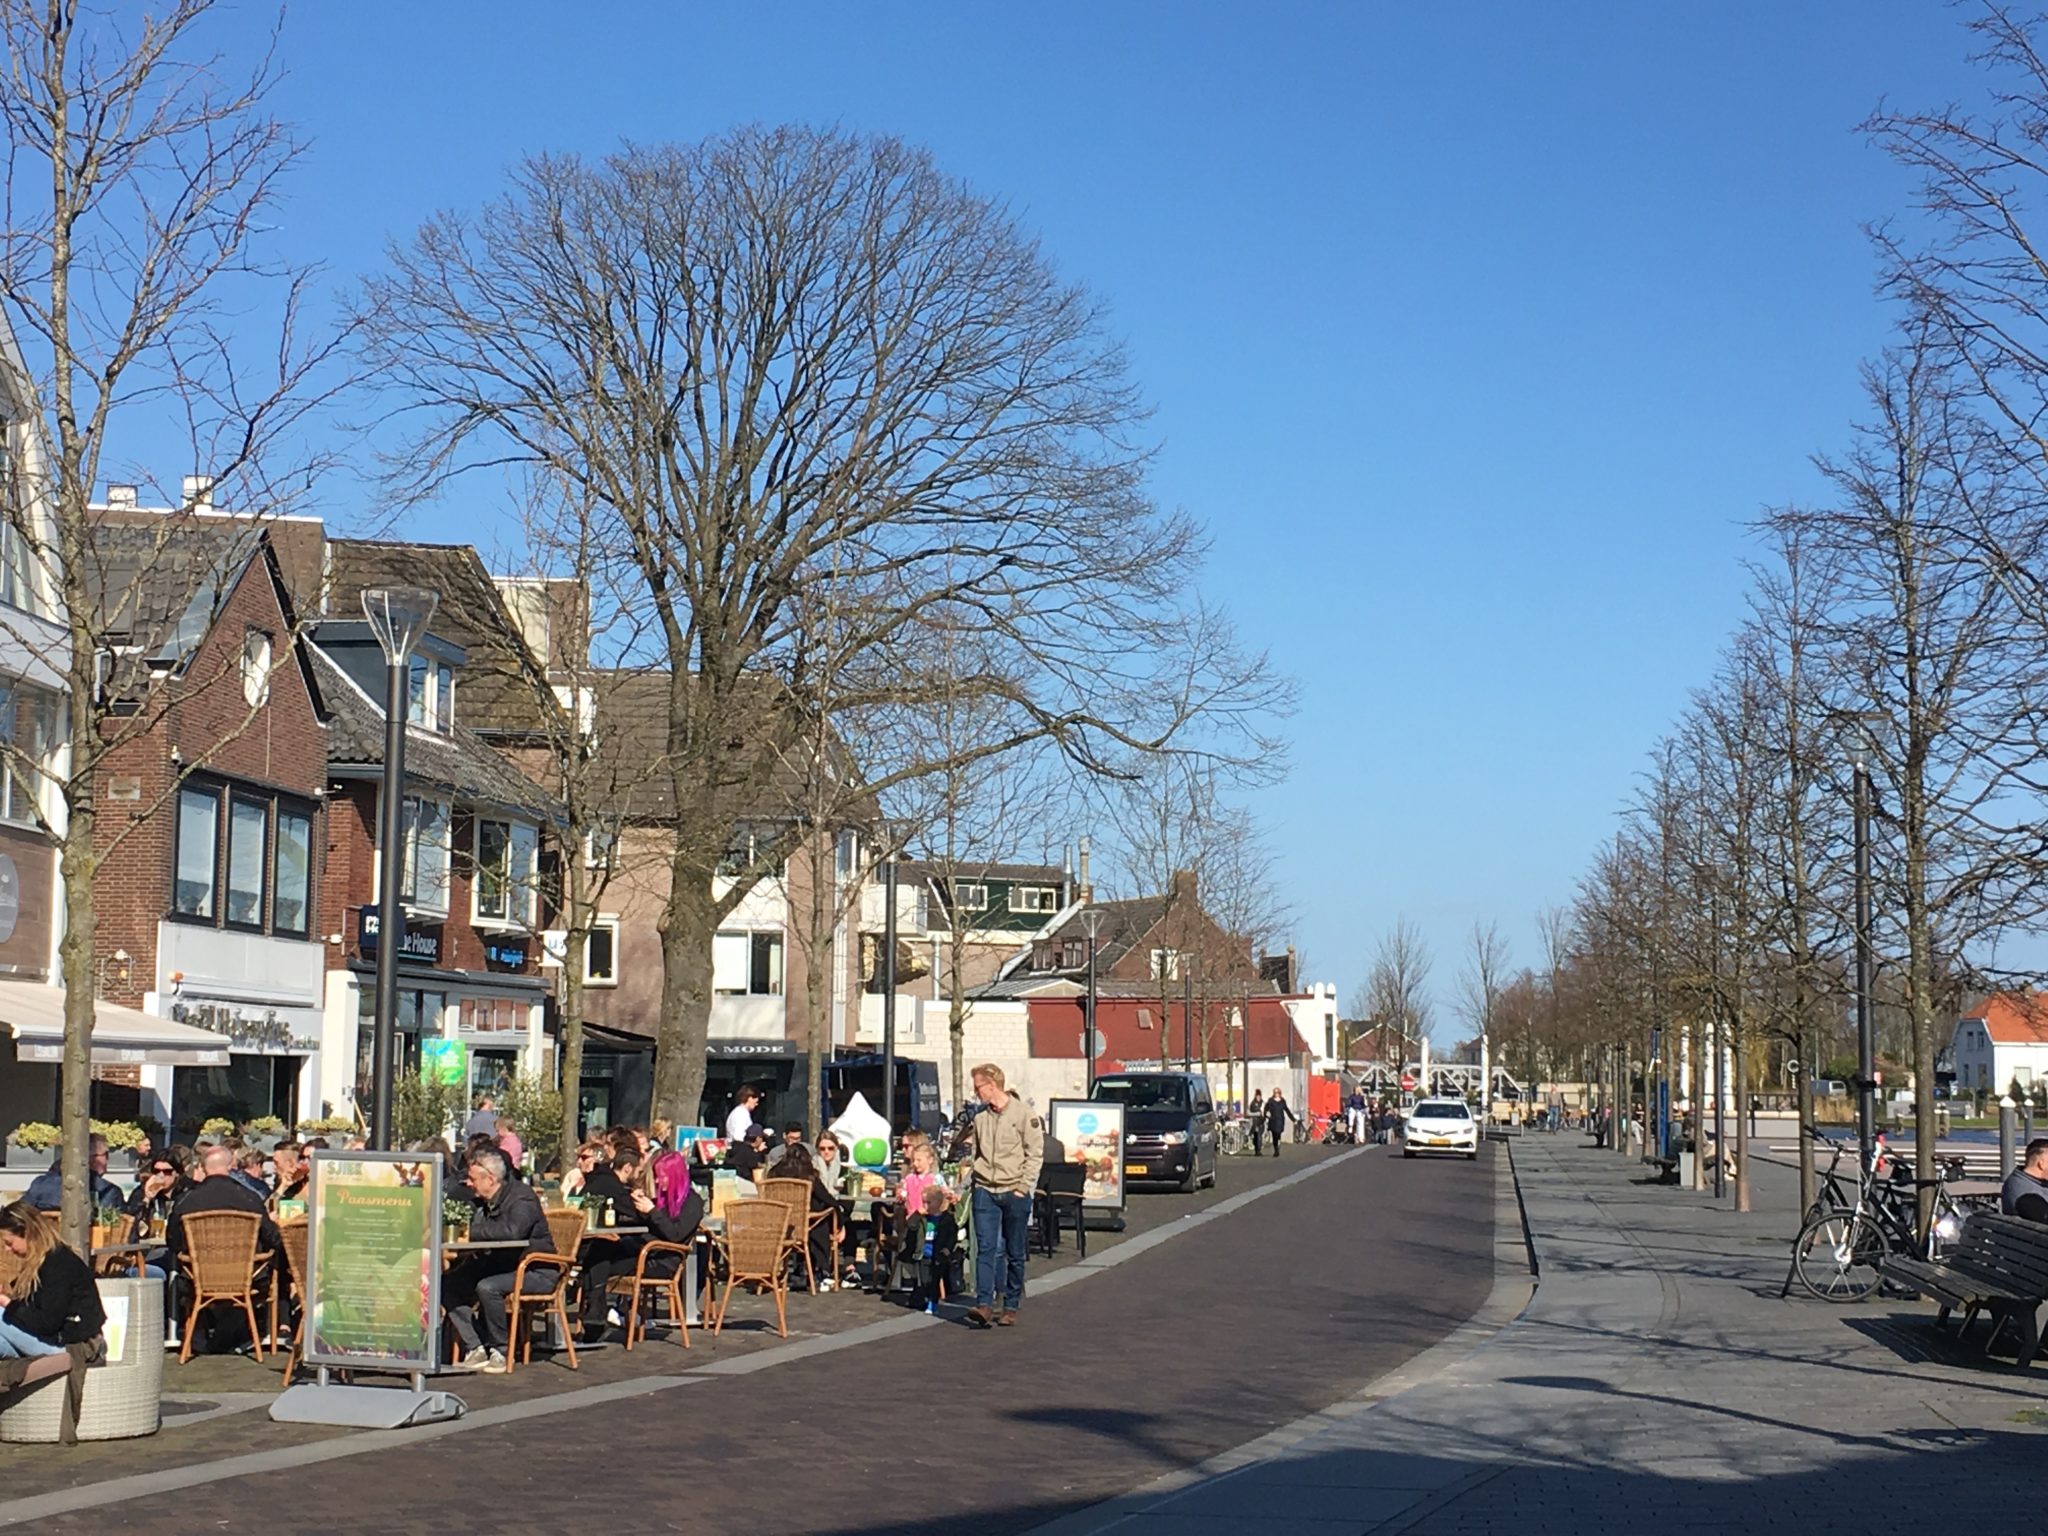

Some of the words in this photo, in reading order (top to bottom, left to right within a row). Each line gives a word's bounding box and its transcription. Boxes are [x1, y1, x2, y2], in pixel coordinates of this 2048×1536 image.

[412, 931, 438, 955] House
[723, 1045, 785, 1054] MODE
[337, 1187, 413, 1207] Paasmenu
